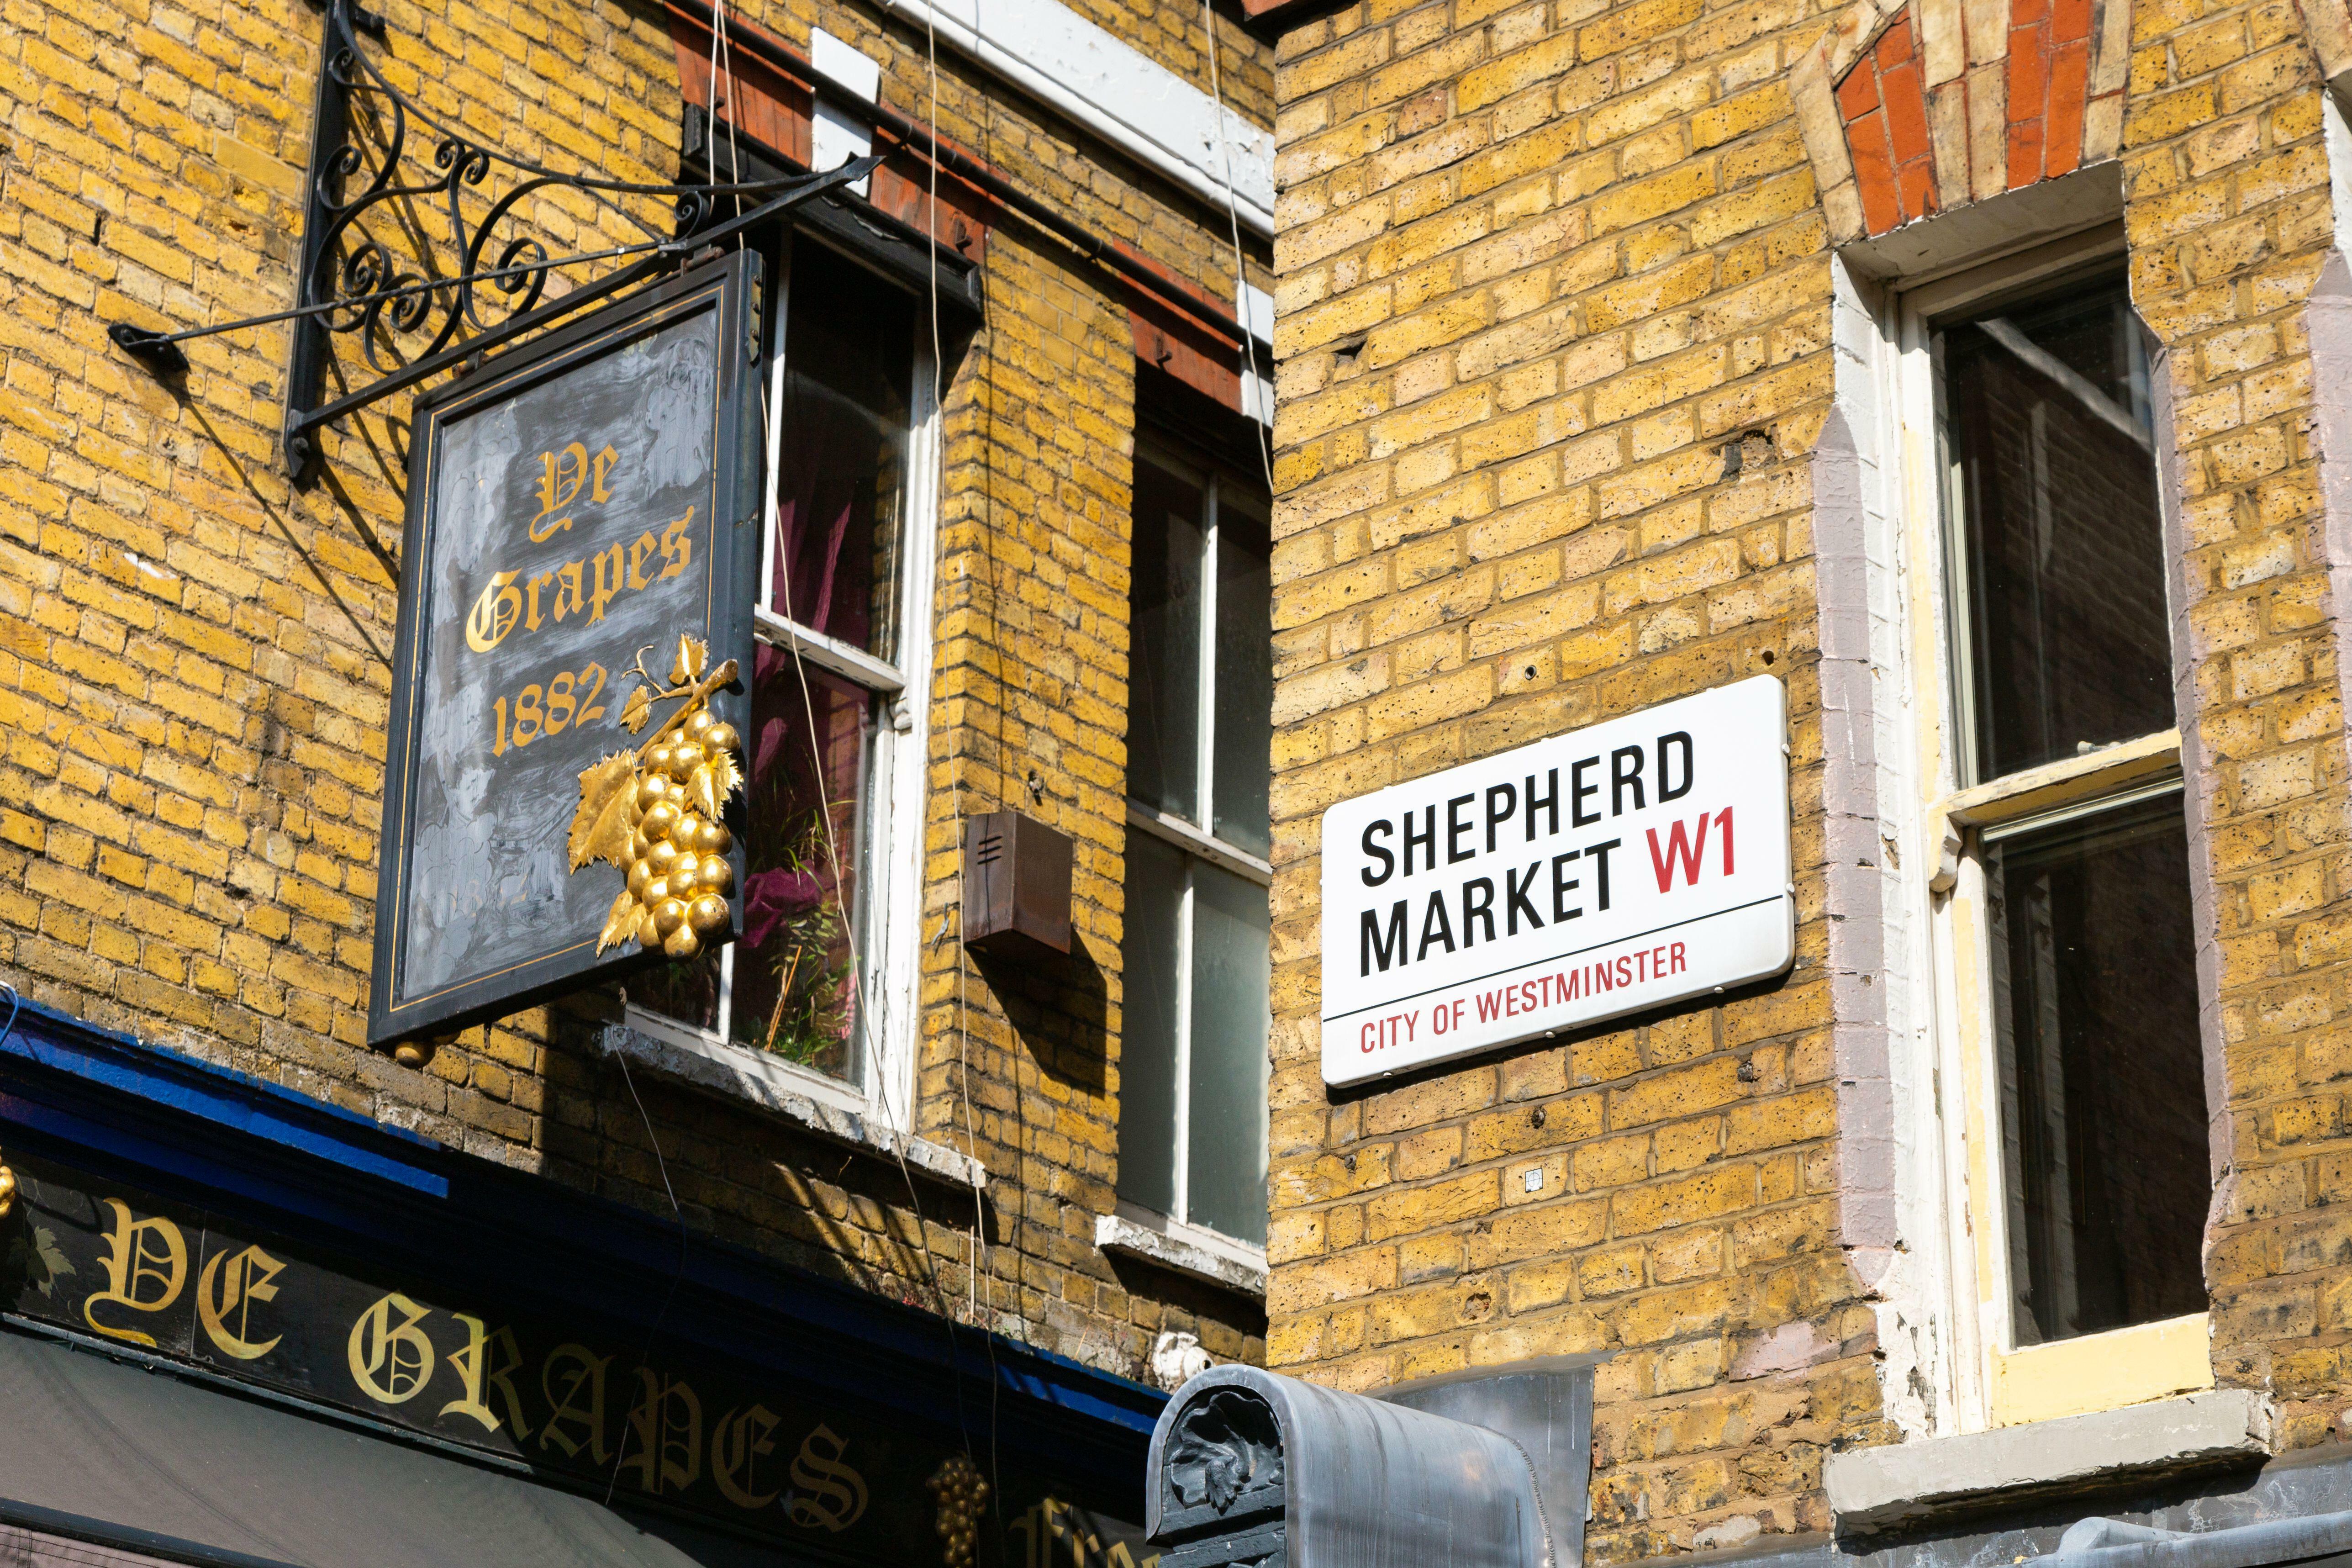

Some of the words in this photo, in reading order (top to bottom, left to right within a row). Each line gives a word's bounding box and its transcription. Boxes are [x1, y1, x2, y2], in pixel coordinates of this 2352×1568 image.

[529, 442, 618, 543] Ye
[466, 506, 694, 653] Grapes
[493, 662, 606, 757] 1882
[1361, 731, 1693, 887] SHEPHERD
[1361, 838, 1621, 977] MARKET
[1646, 806, 1734, 894] W1
[1361, 1010, 1419, 1053] CITY
[1433, 999, 1465, 1035] OF
[1476, 942, 1686, 1023] WESTMINSTER
[84, 1197, 288, 1360] YE
[348, 1289, 869, 1533] GRAPES
